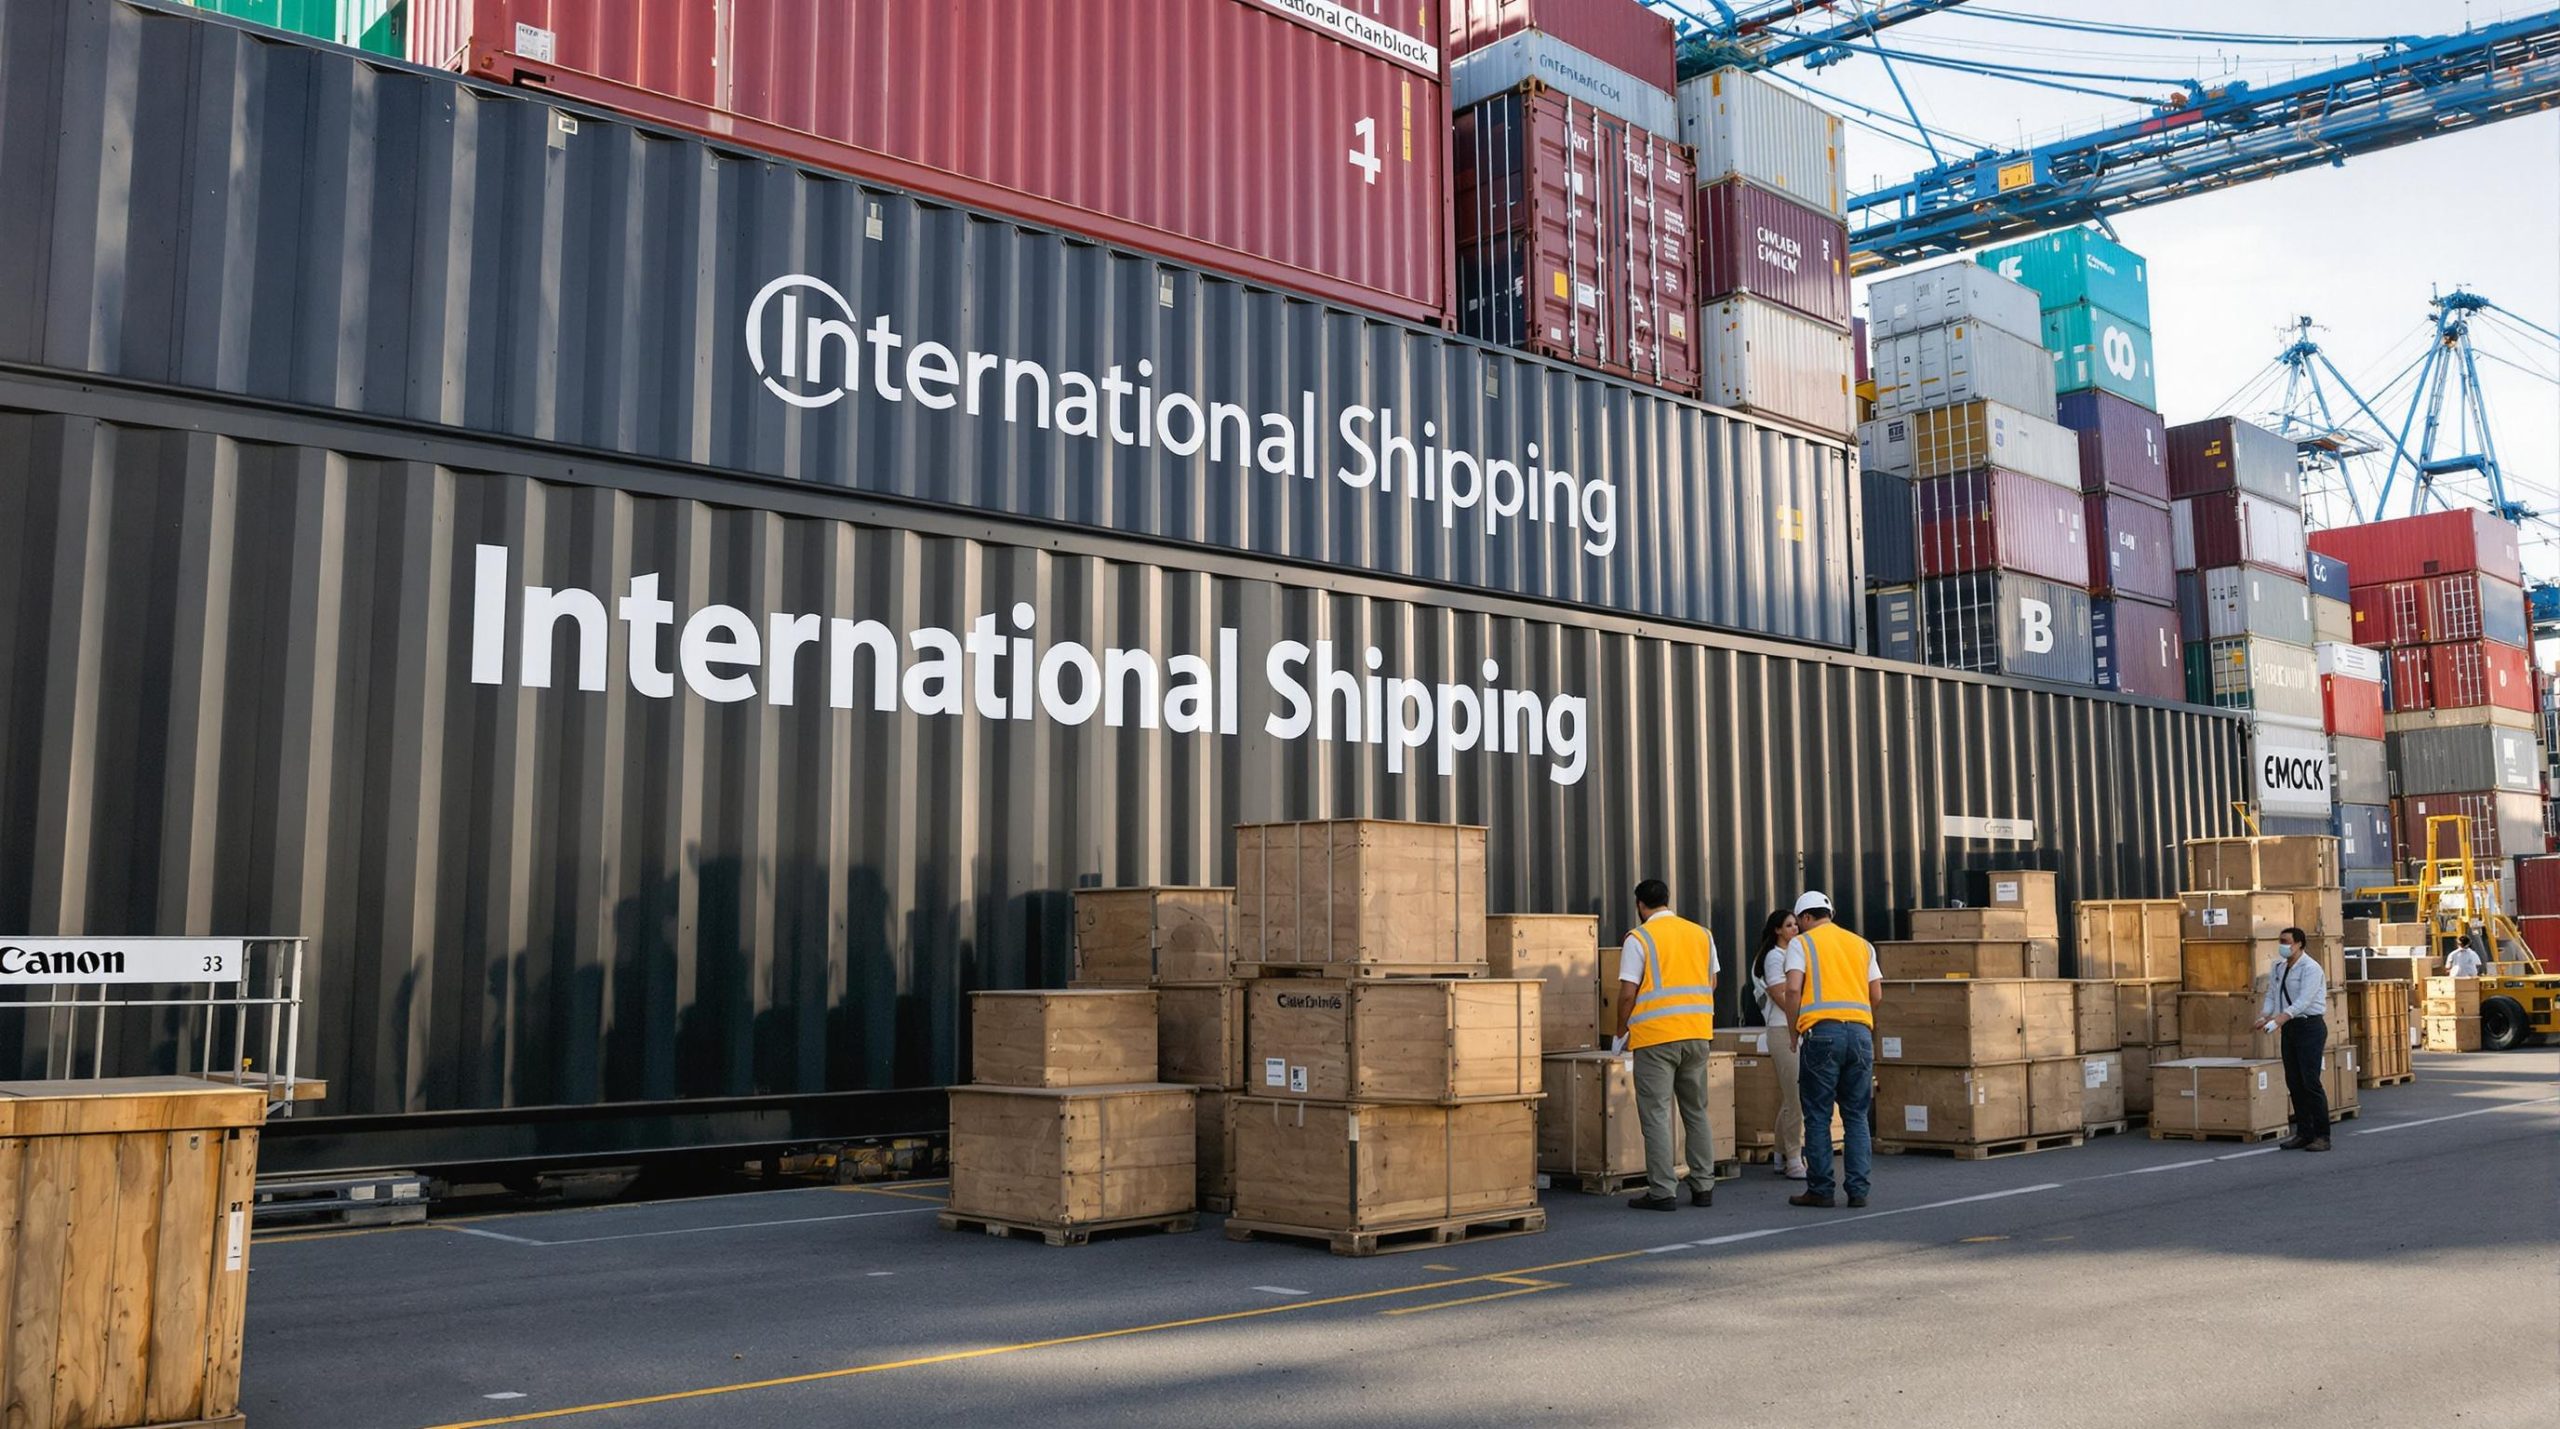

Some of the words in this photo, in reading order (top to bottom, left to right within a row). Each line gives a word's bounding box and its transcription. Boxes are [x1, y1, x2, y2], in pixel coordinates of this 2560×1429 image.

[1280, 0, 1340, 27] ational
[779, 292, 1314, 479] International
[1337, 404, 1617, 557] Shipping
[2020, 597, 2054, 654] B
[471, 543, 1238, 735] International
[1264, 639, 1588, 786] Shipping
[2264, 755, 2323, 791] EMOCK
[0, 946, 125, 975] Canon
[203, 955, 223, 972] 33
